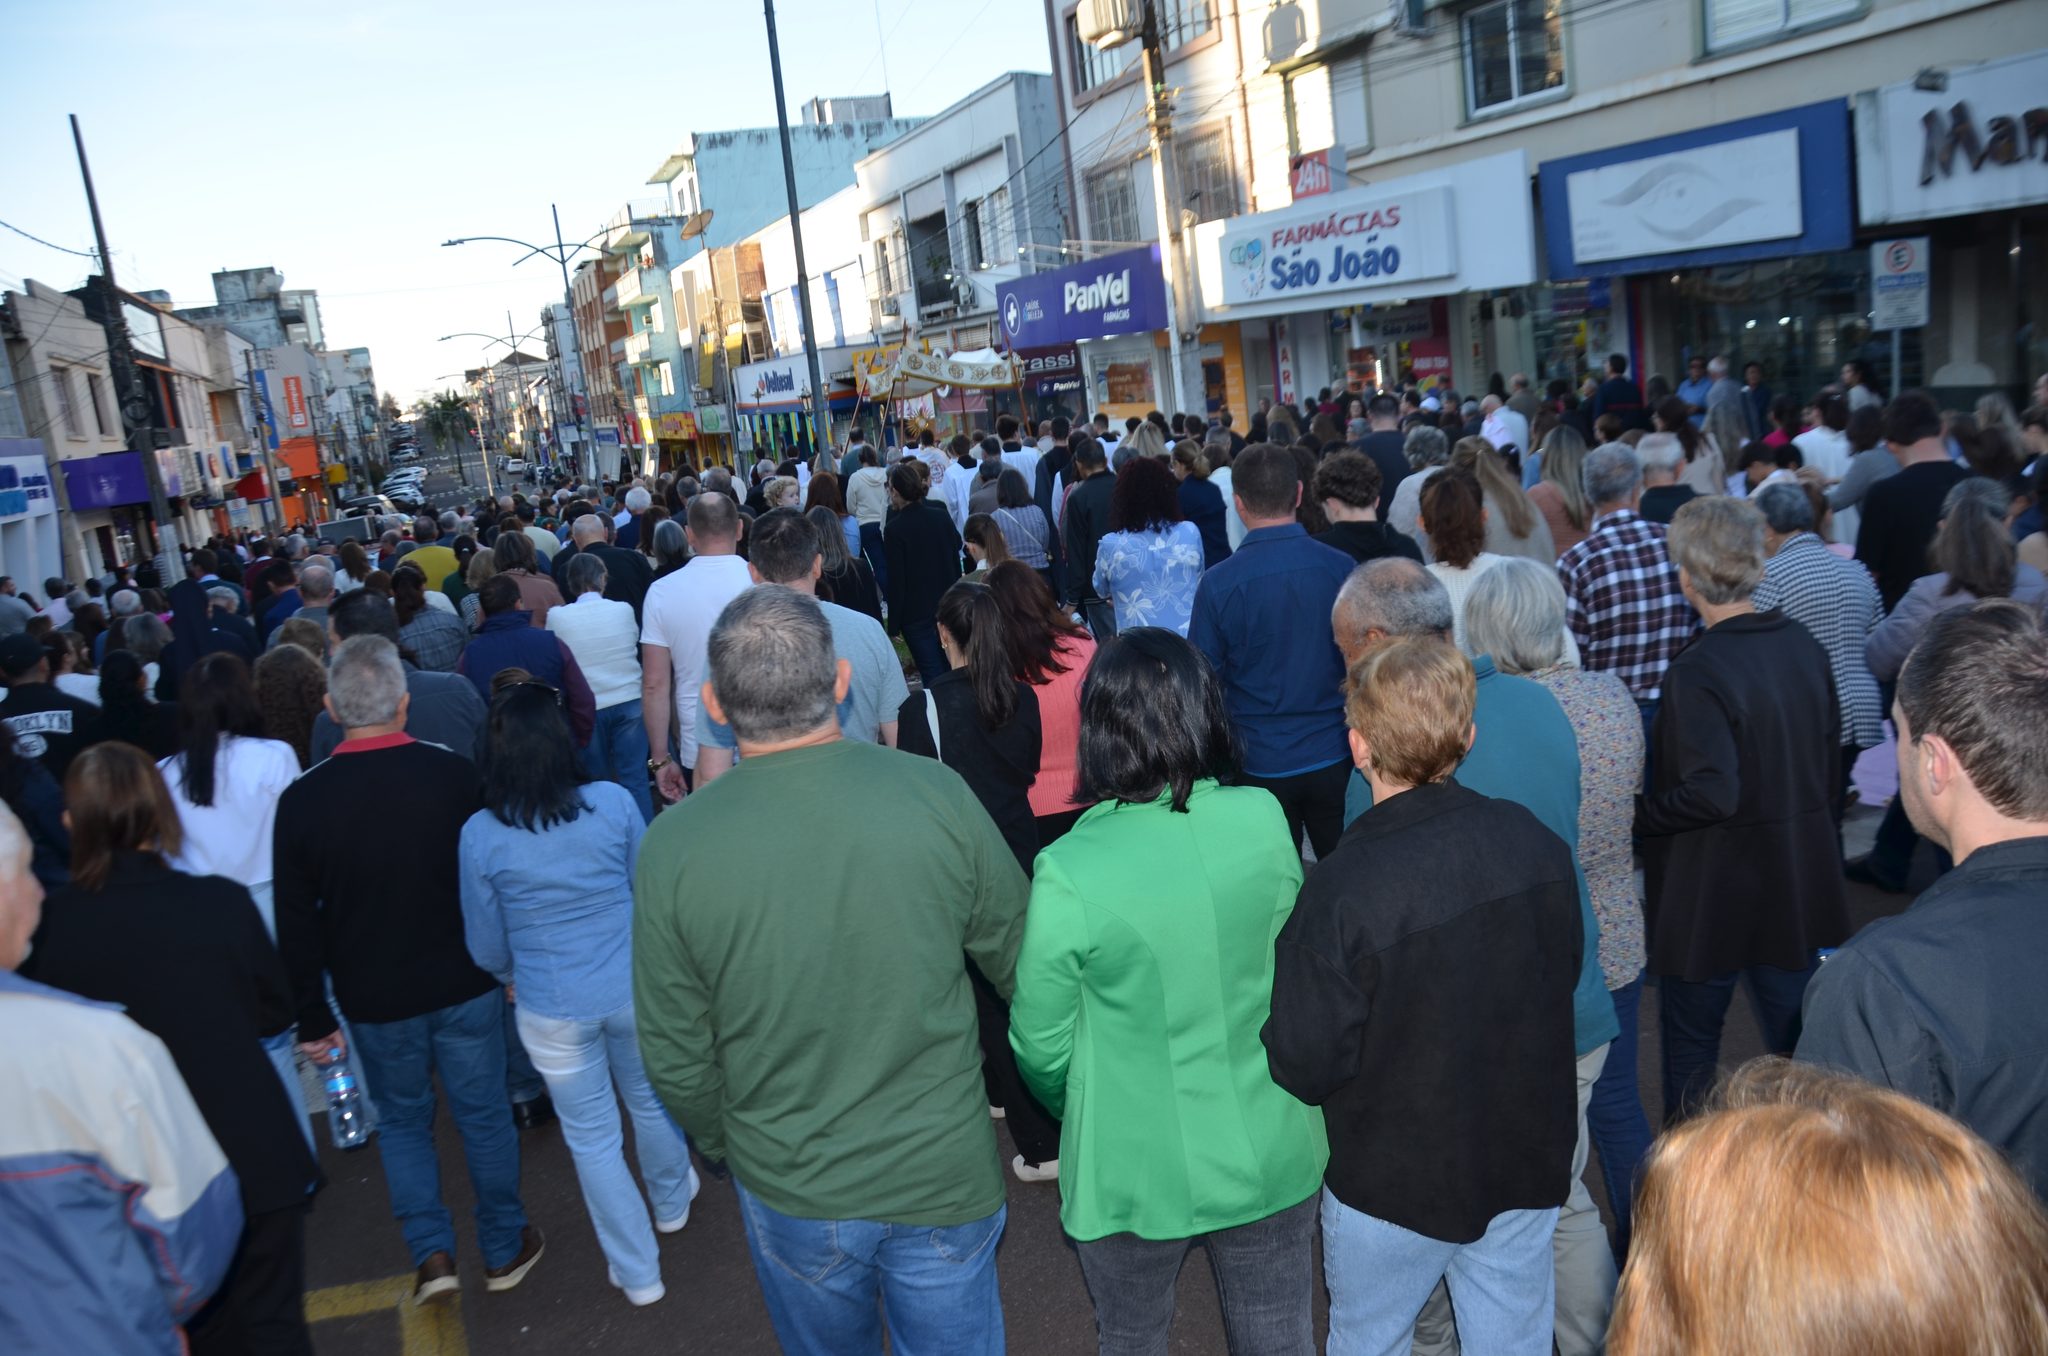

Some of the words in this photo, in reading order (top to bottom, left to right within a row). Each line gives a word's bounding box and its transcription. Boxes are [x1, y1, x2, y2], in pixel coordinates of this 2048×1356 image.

[1295, 157, 1327, 193] 24h
[1272, 205, 1401, 248] FARMÁCIAS
[1270, 248, 1320, 290] São
[1328, 233, 1400, 284] João
[1064, 268, 1130, 315] PanVel
[1103, 308, 1130, 323] FARMÁCIAS
[1053, 380, 1081, 392] PanVel
